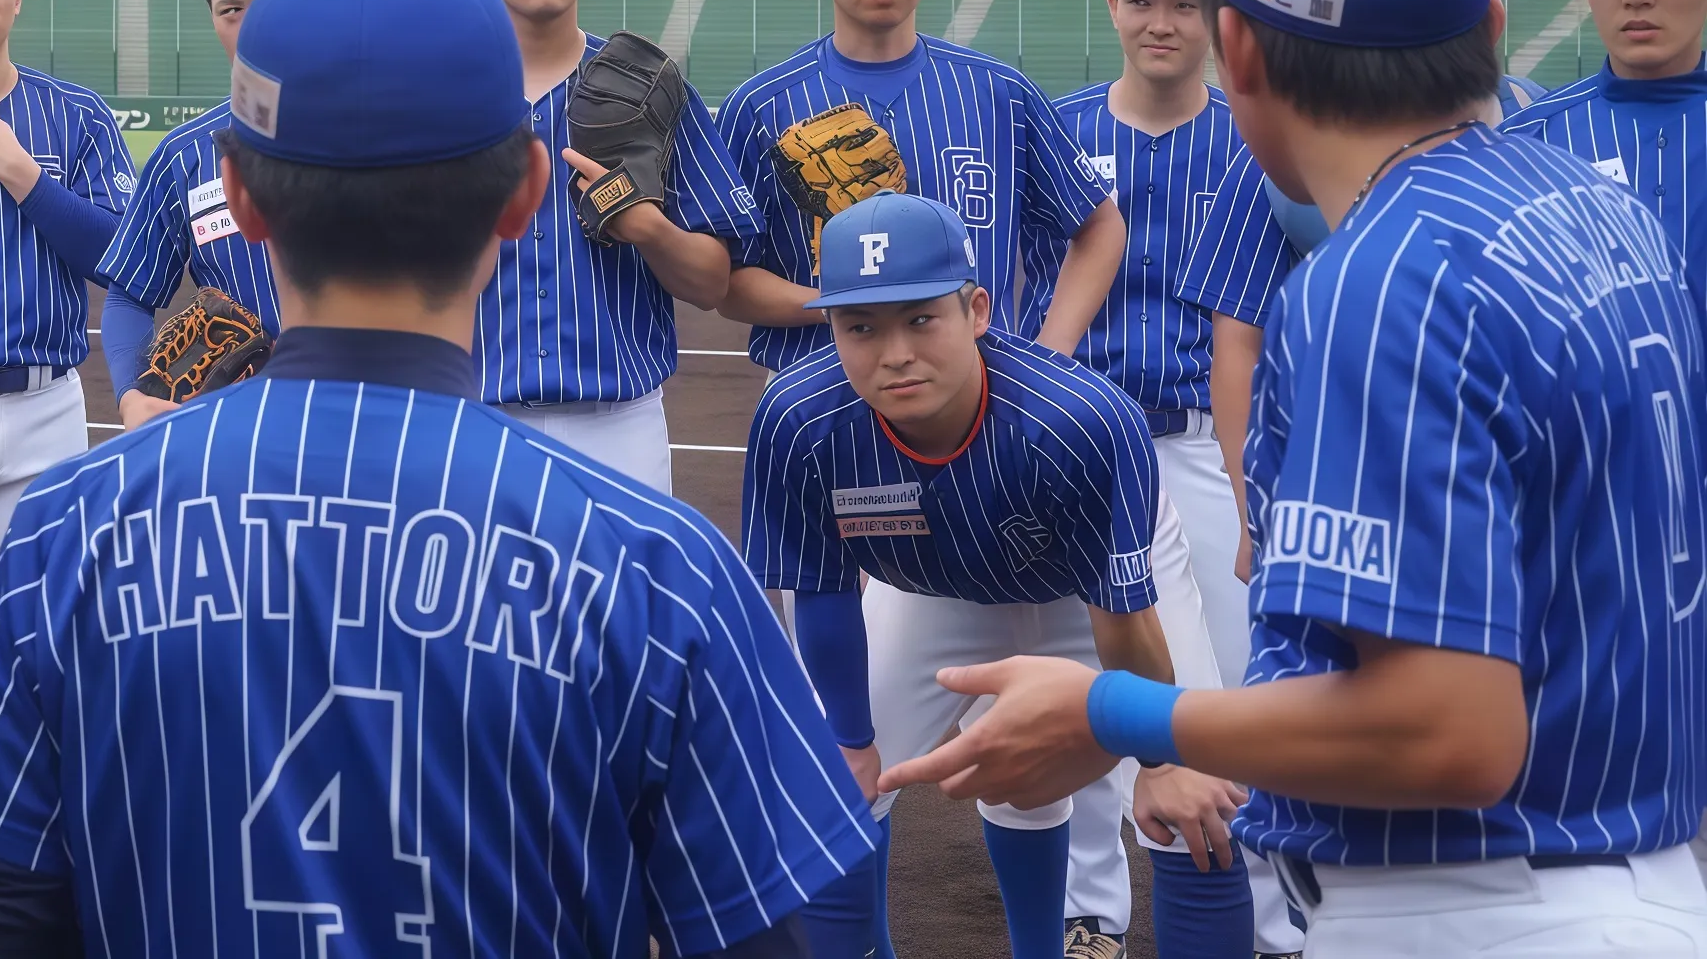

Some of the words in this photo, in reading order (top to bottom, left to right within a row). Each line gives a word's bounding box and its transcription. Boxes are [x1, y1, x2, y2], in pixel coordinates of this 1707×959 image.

[858, 231, 890, 276] F
[93, 493, 604, 684] HATTORI
[1266, 500, 1392, 583] UOKA
[240, 684, 435, 959] 4
